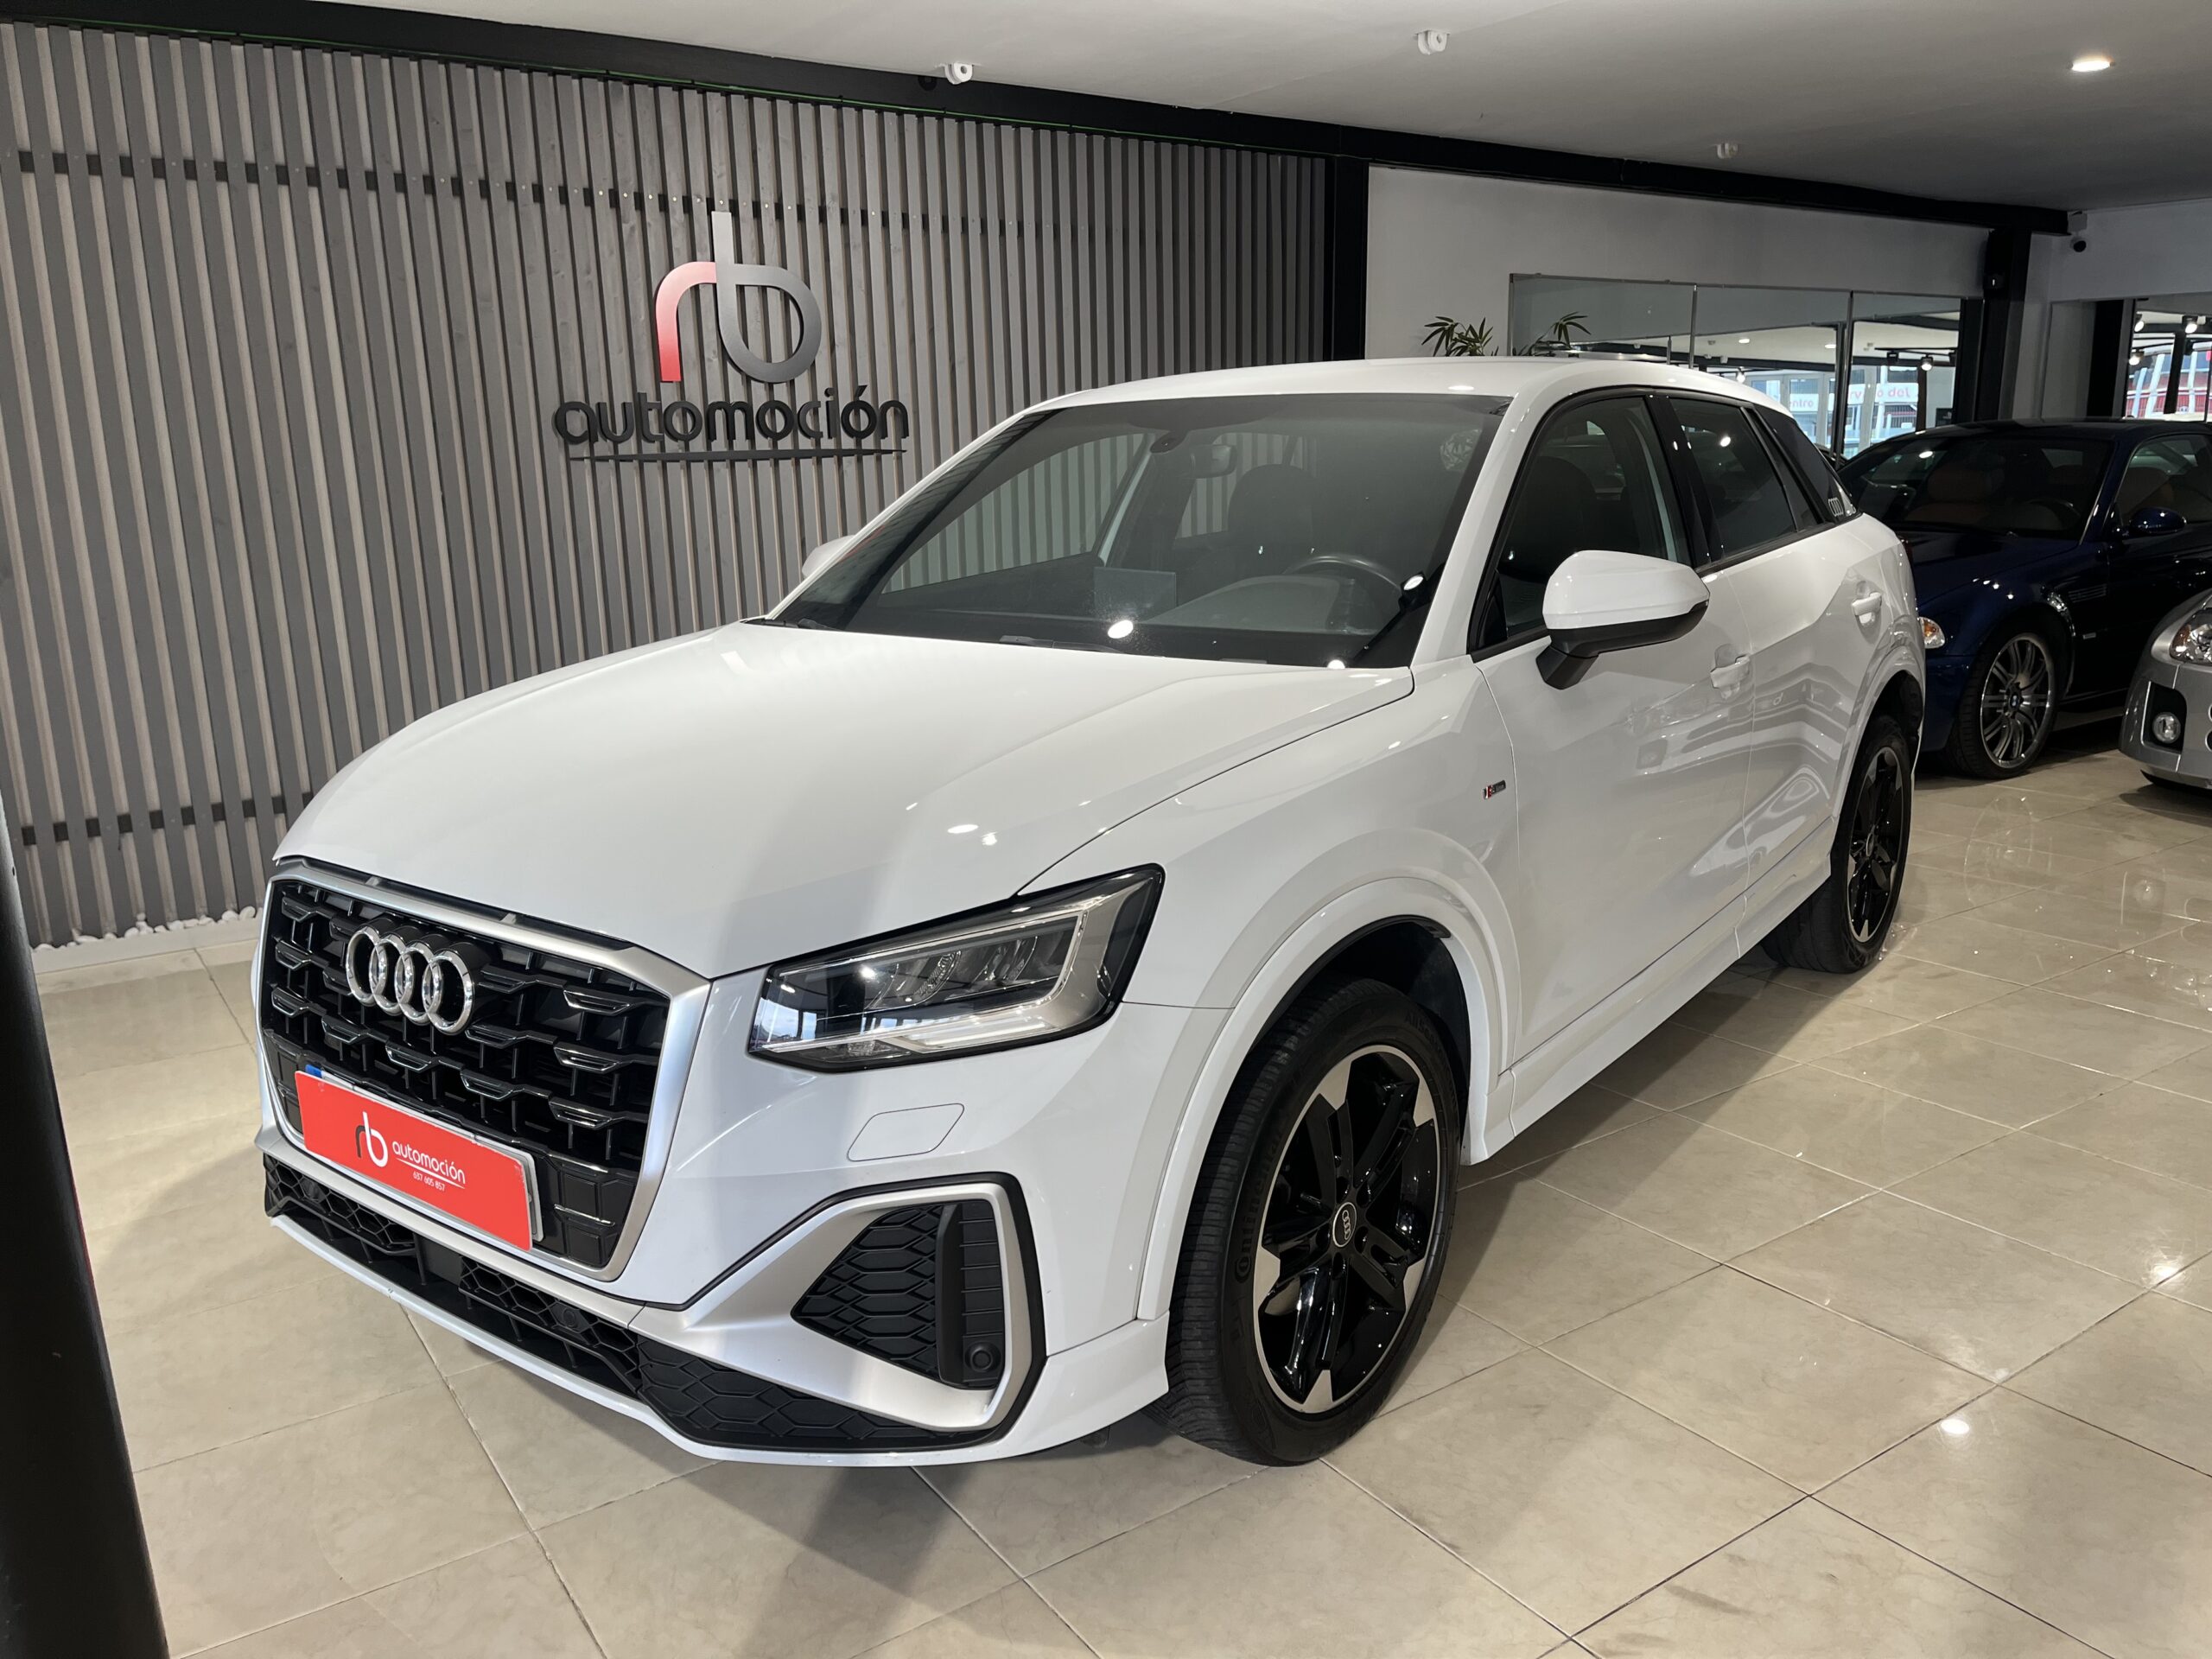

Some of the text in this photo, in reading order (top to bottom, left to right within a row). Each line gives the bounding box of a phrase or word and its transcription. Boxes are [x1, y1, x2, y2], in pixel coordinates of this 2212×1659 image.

[554, 385, 909, 444] automoción
[392, 1141, 466, 1185] automoción
[435, 1180, 445, 1192] 857
